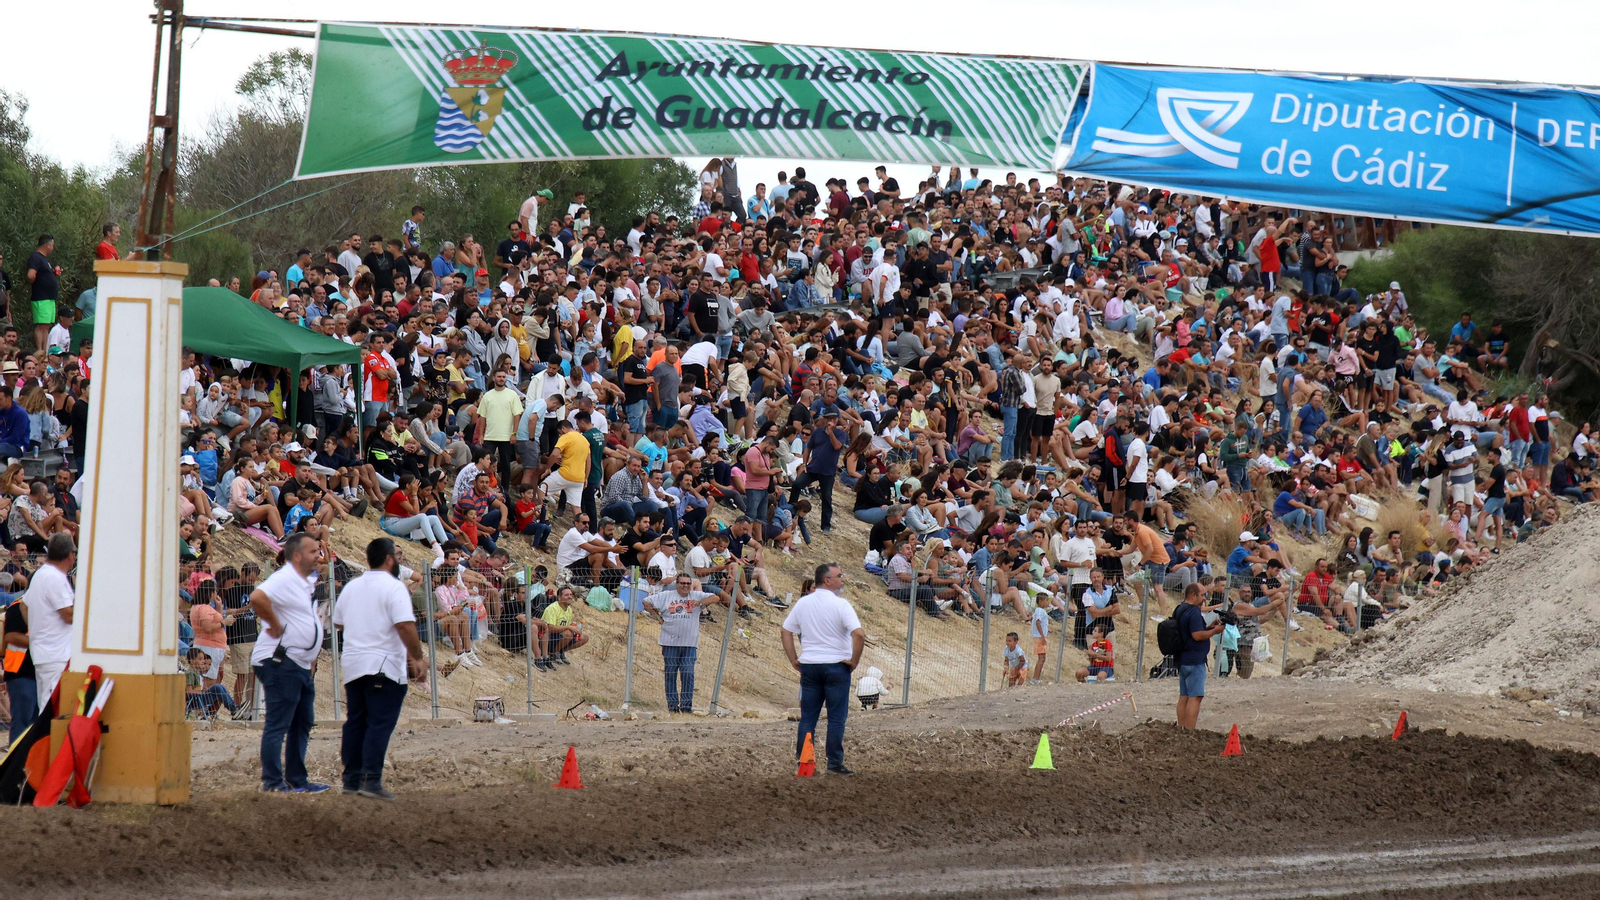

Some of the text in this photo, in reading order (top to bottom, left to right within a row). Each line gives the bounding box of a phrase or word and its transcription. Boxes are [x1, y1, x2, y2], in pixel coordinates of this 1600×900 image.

[595, 50, 930, 86] Ayuntamiento
[582, 94, 953, 138] de Guadalcacín
[1270, 92, 1495, 141] Diputación
[1261, 138, 1450, 191] de Cádiz
